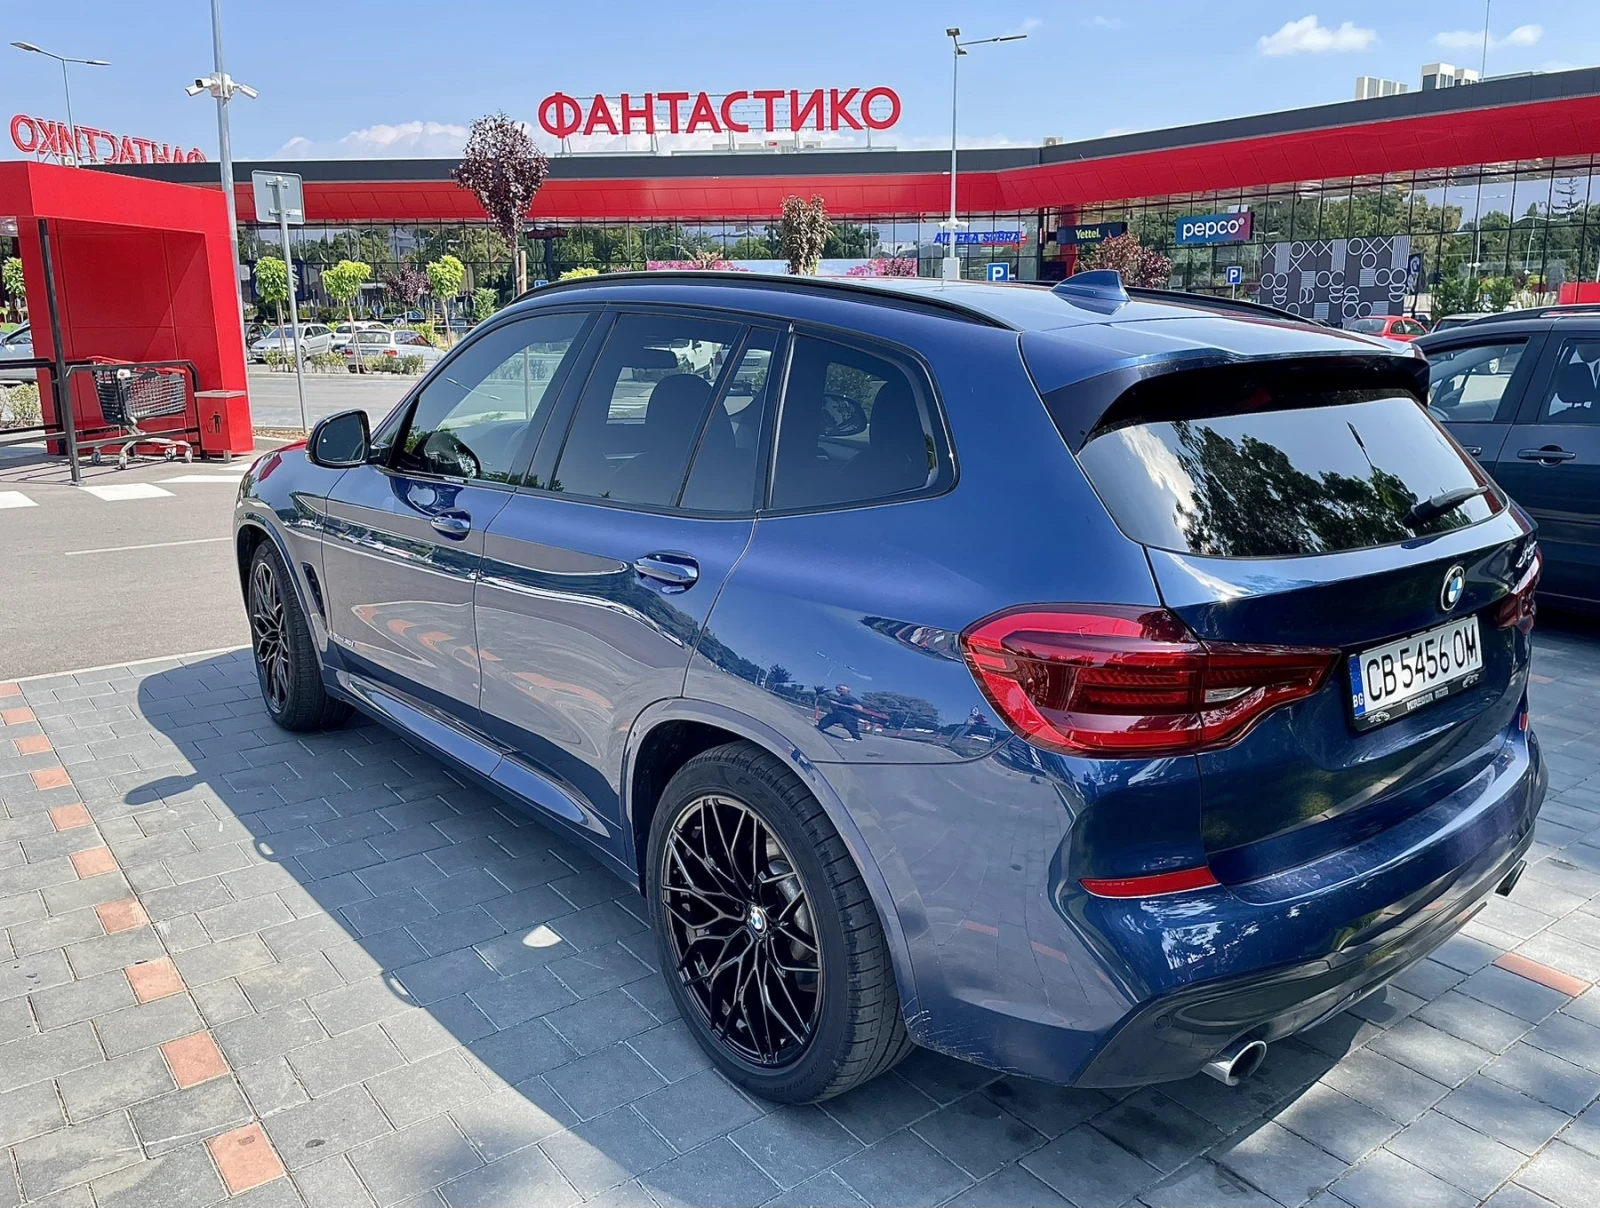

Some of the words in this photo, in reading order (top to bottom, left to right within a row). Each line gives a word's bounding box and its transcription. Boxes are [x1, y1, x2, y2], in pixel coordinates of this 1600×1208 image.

[538, 87, 901, 138] ФАНТАСТИКО
[992, 266, 1005, 281] P
[1229, 269, 1239, 282] P
[1366, 653, 1397, 701] CB
[1399, 634, 1451, 689] 5456
[1453, 624, 1479, 669] OM
[1352, 692, 1364, 708] BG
